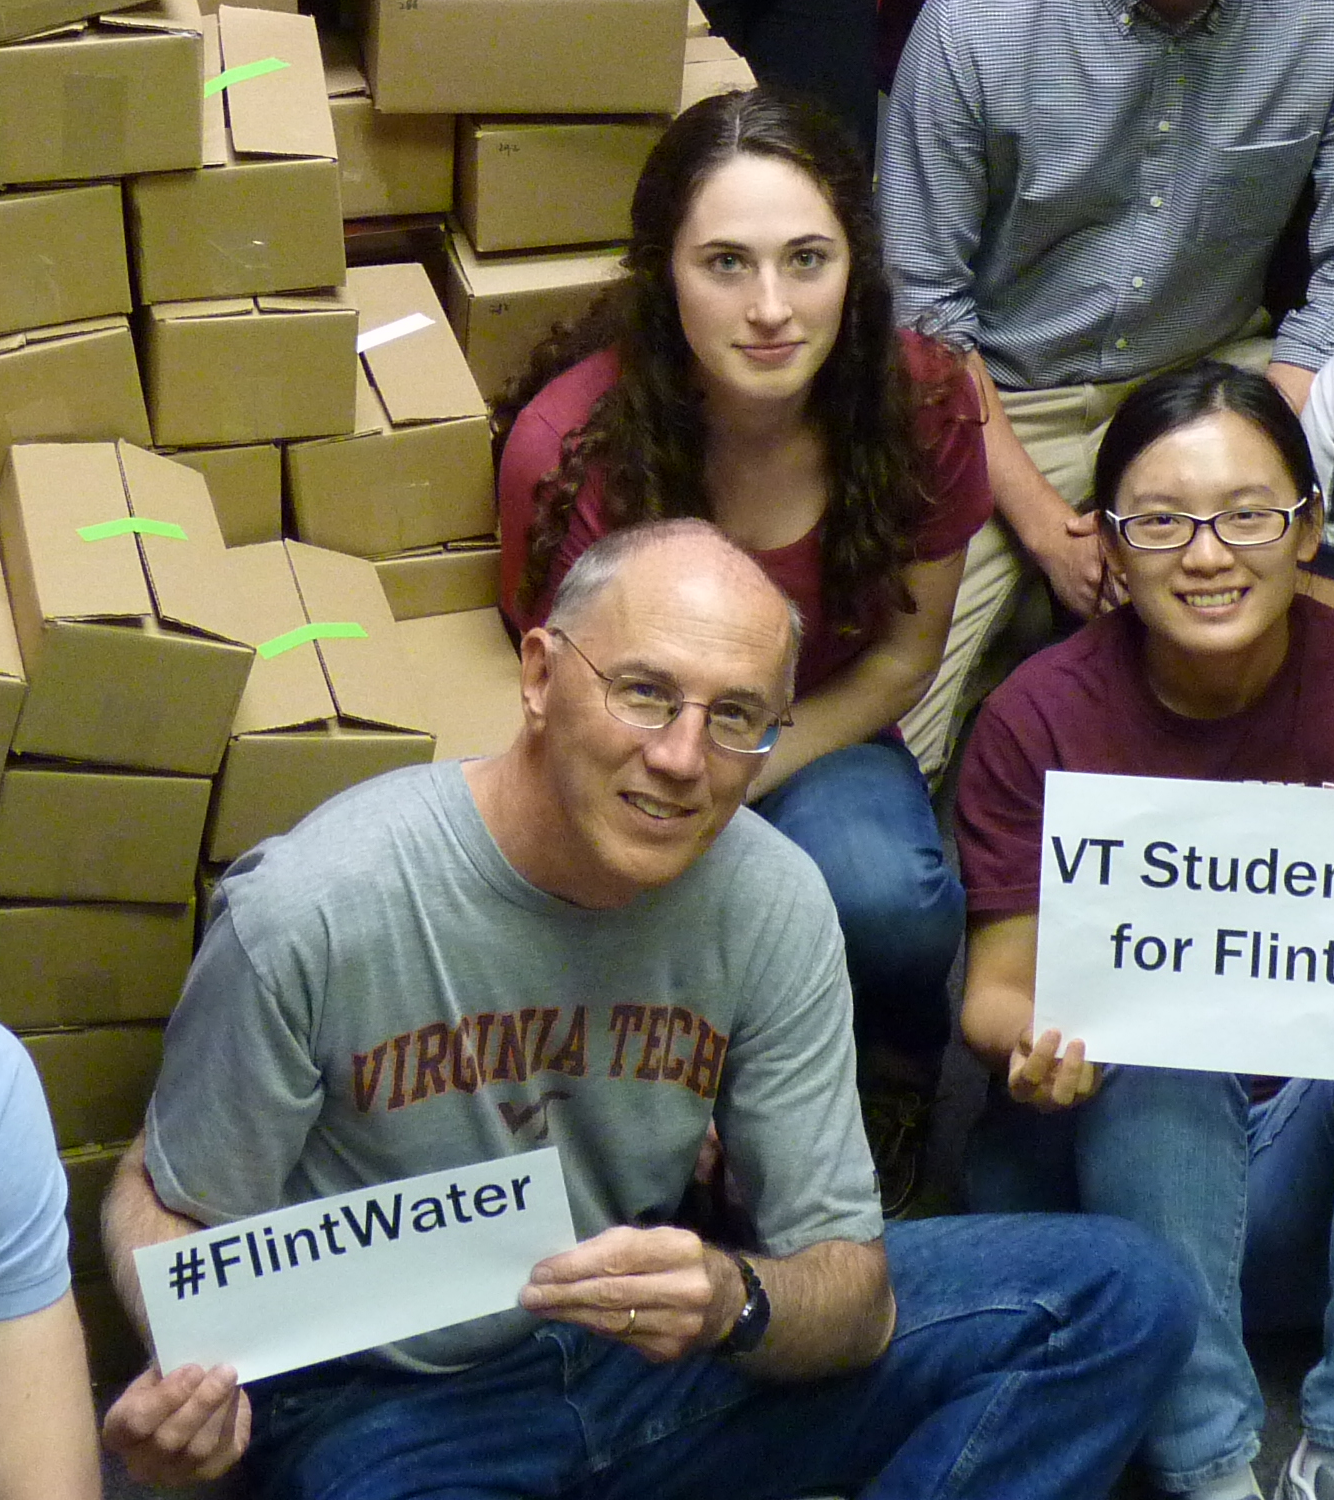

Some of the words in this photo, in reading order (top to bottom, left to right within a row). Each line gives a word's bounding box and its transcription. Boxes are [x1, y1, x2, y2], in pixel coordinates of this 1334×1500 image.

[1050, 835, 1125, 886] VT
[1110, 922, 1194, 973] for
[352, 1006, 589, 1114] VIRGINIA
[608, 1003, 728, 1100] TECH
[168, 1173, 534, 1301] #FlintWater
